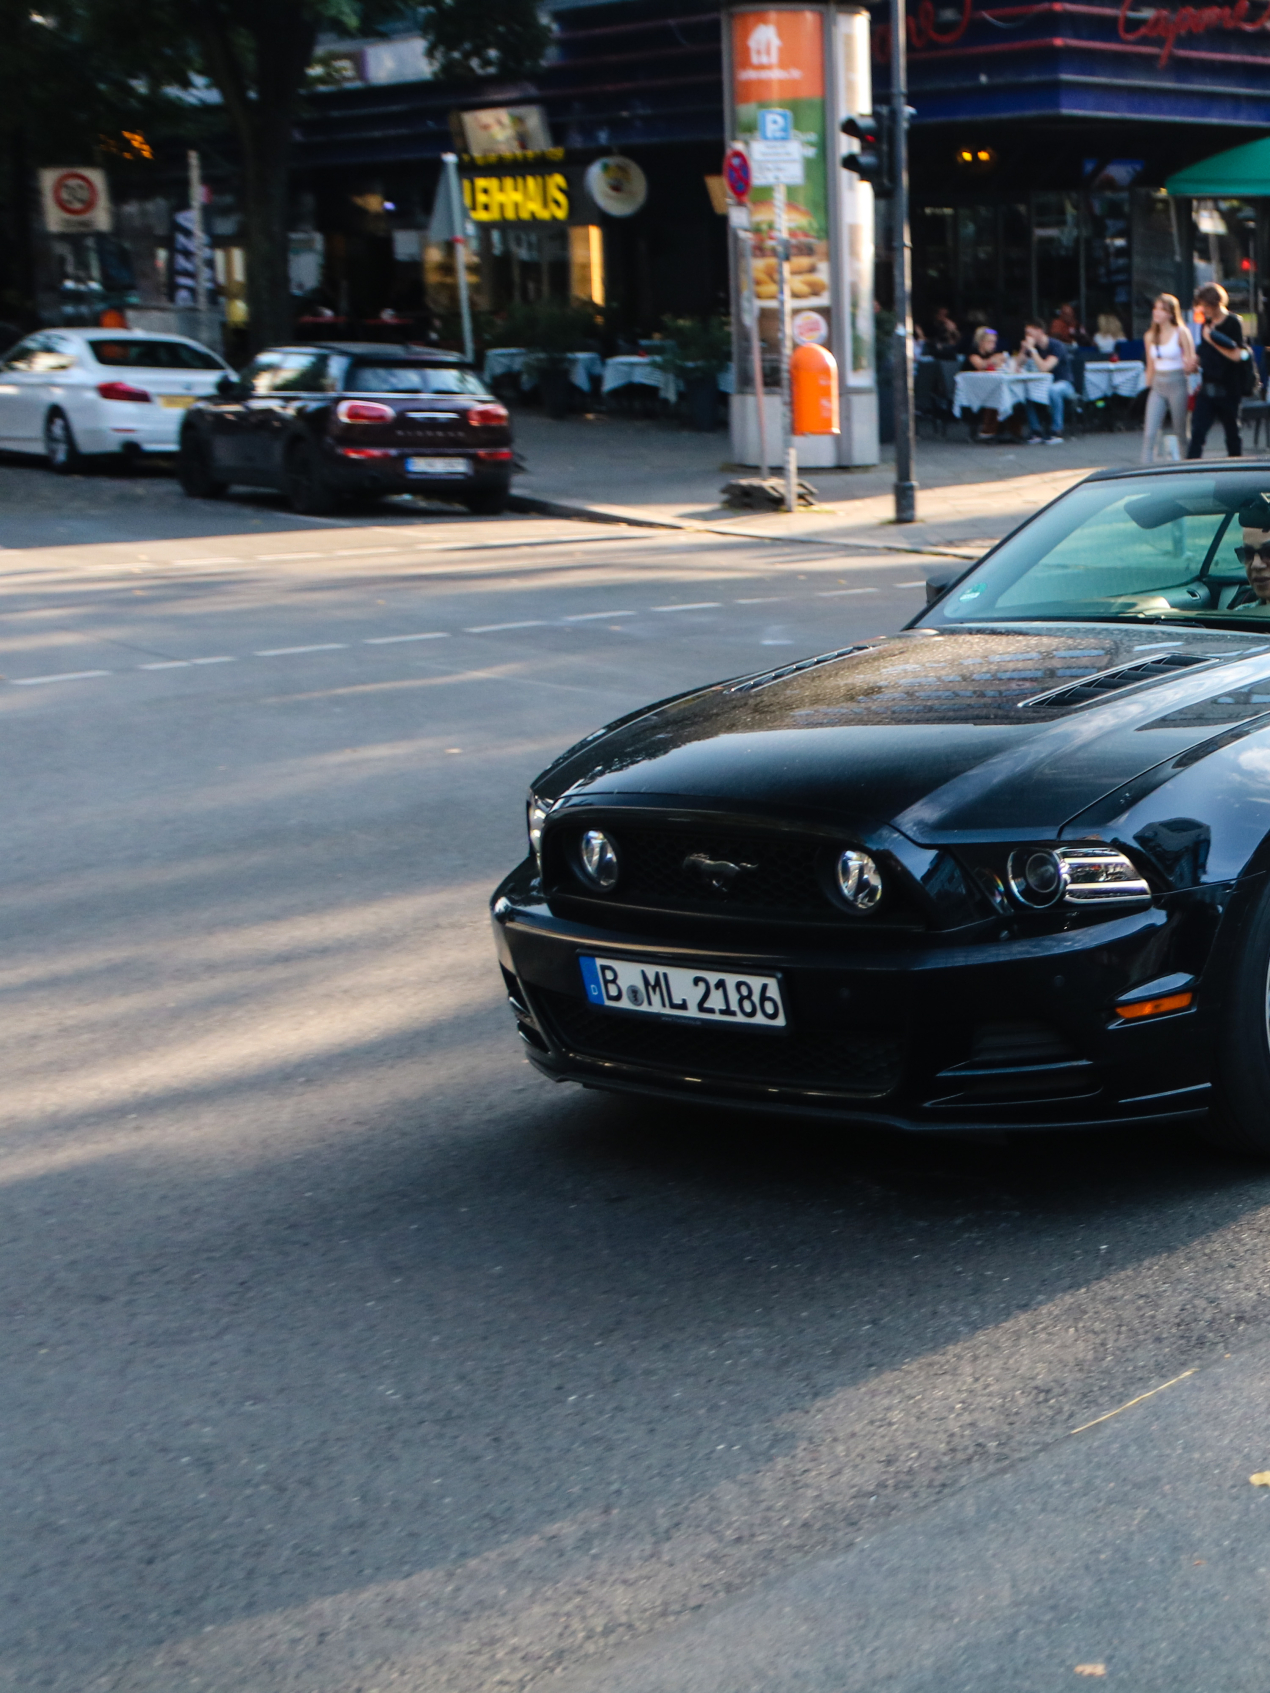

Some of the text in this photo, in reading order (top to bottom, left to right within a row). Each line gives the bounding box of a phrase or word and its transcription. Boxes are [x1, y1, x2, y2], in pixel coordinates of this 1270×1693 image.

[462, 172, 569, 222] LEIHHAUS
[600, 963, 780, 1021] B ML 2186
